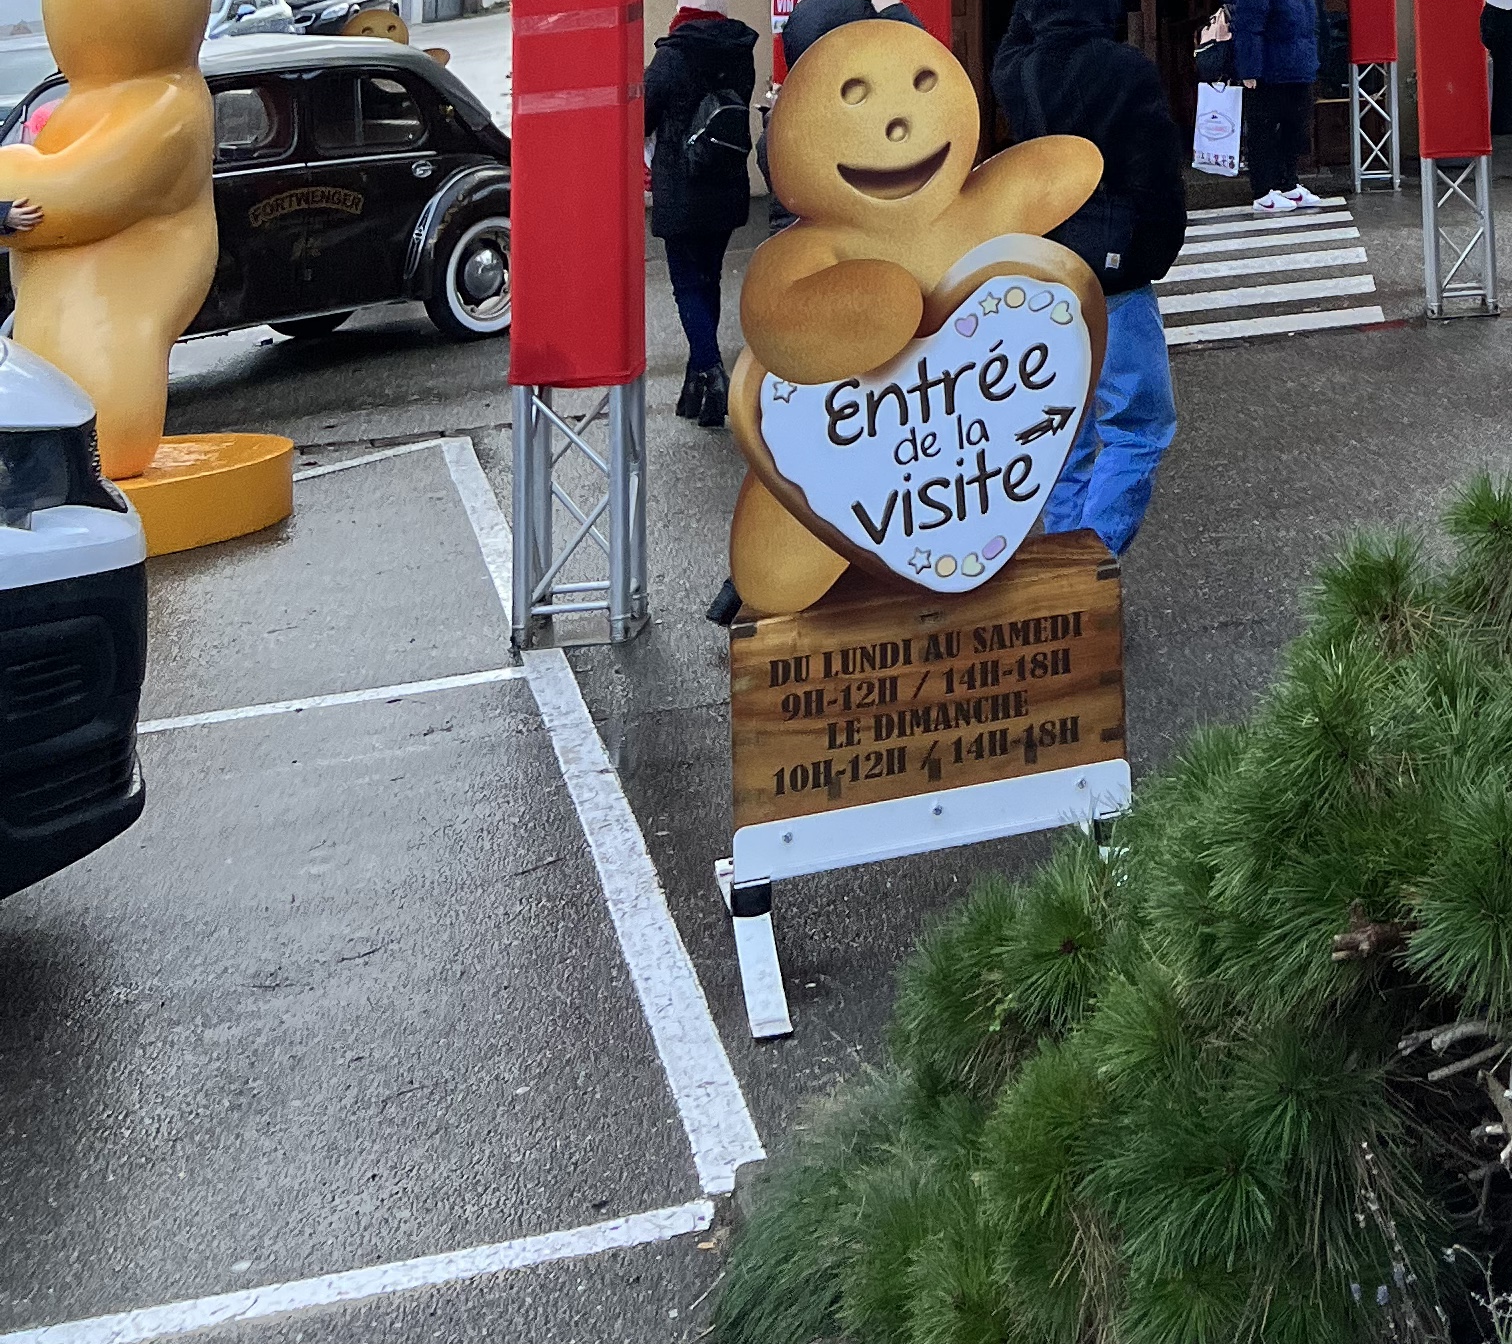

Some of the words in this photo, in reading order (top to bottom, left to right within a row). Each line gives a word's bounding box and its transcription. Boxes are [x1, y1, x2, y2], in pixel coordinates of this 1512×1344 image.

[894, 427, 941, 465] de
[956, 414, 990, 449] la
[851, 448, 1040, 544] visite
[769, 654, 811, 688] DU
[822, 638, 913, 679] LUNDI
[923, 630, 961, 662] AU
[974, 611, 1084, 654] SAMEDI
[781, 677, 898, 722] 9H-12H
[942, 648, 1071, 695] 14H-18H
[773, 746, 907, 796] 10H-12H
[952, 716, 1080, 764] 14H-18H
[827, 717, 861, 750] LE
[873, 689, 1029, 743] DIMANCHE
